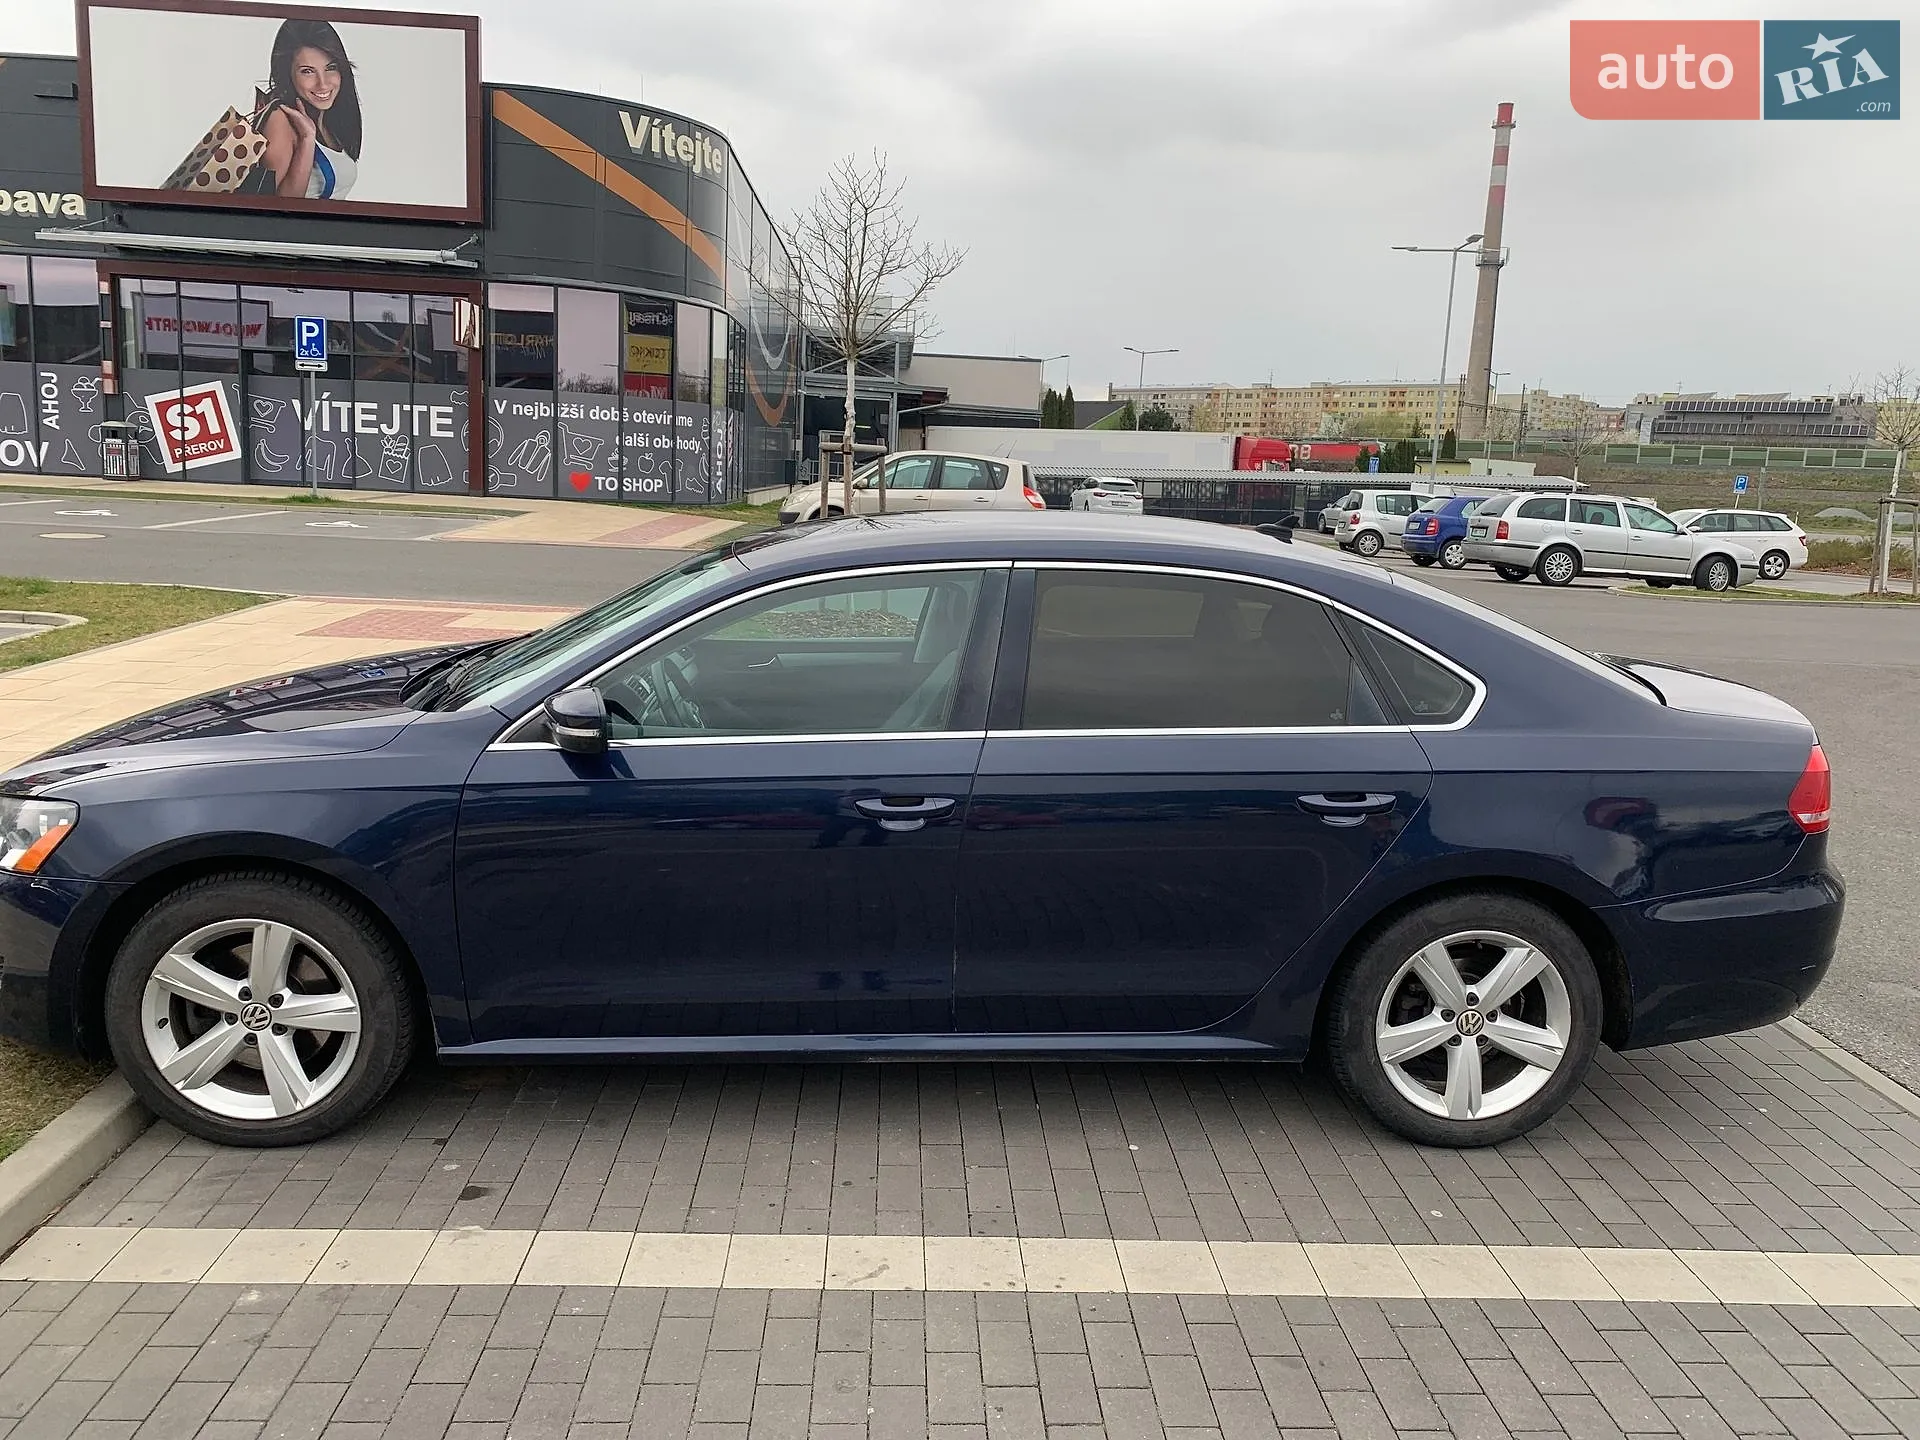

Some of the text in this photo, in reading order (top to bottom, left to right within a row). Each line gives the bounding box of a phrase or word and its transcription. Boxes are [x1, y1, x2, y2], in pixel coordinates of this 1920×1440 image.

[618, 110, 722, 174] Vítejte
[302, 321, 319, 346] P
[40, 371, 60, 430] AHOJ
[291, 391, 454, 438] VÍTEJTE
[494, 399, 693, 427] V nejbližší době otevírme
[165, 397, 221, 441] S1
[174, 438, 225, 459] PŘEROV
[594, 476, 663, 493] TO SHOP
